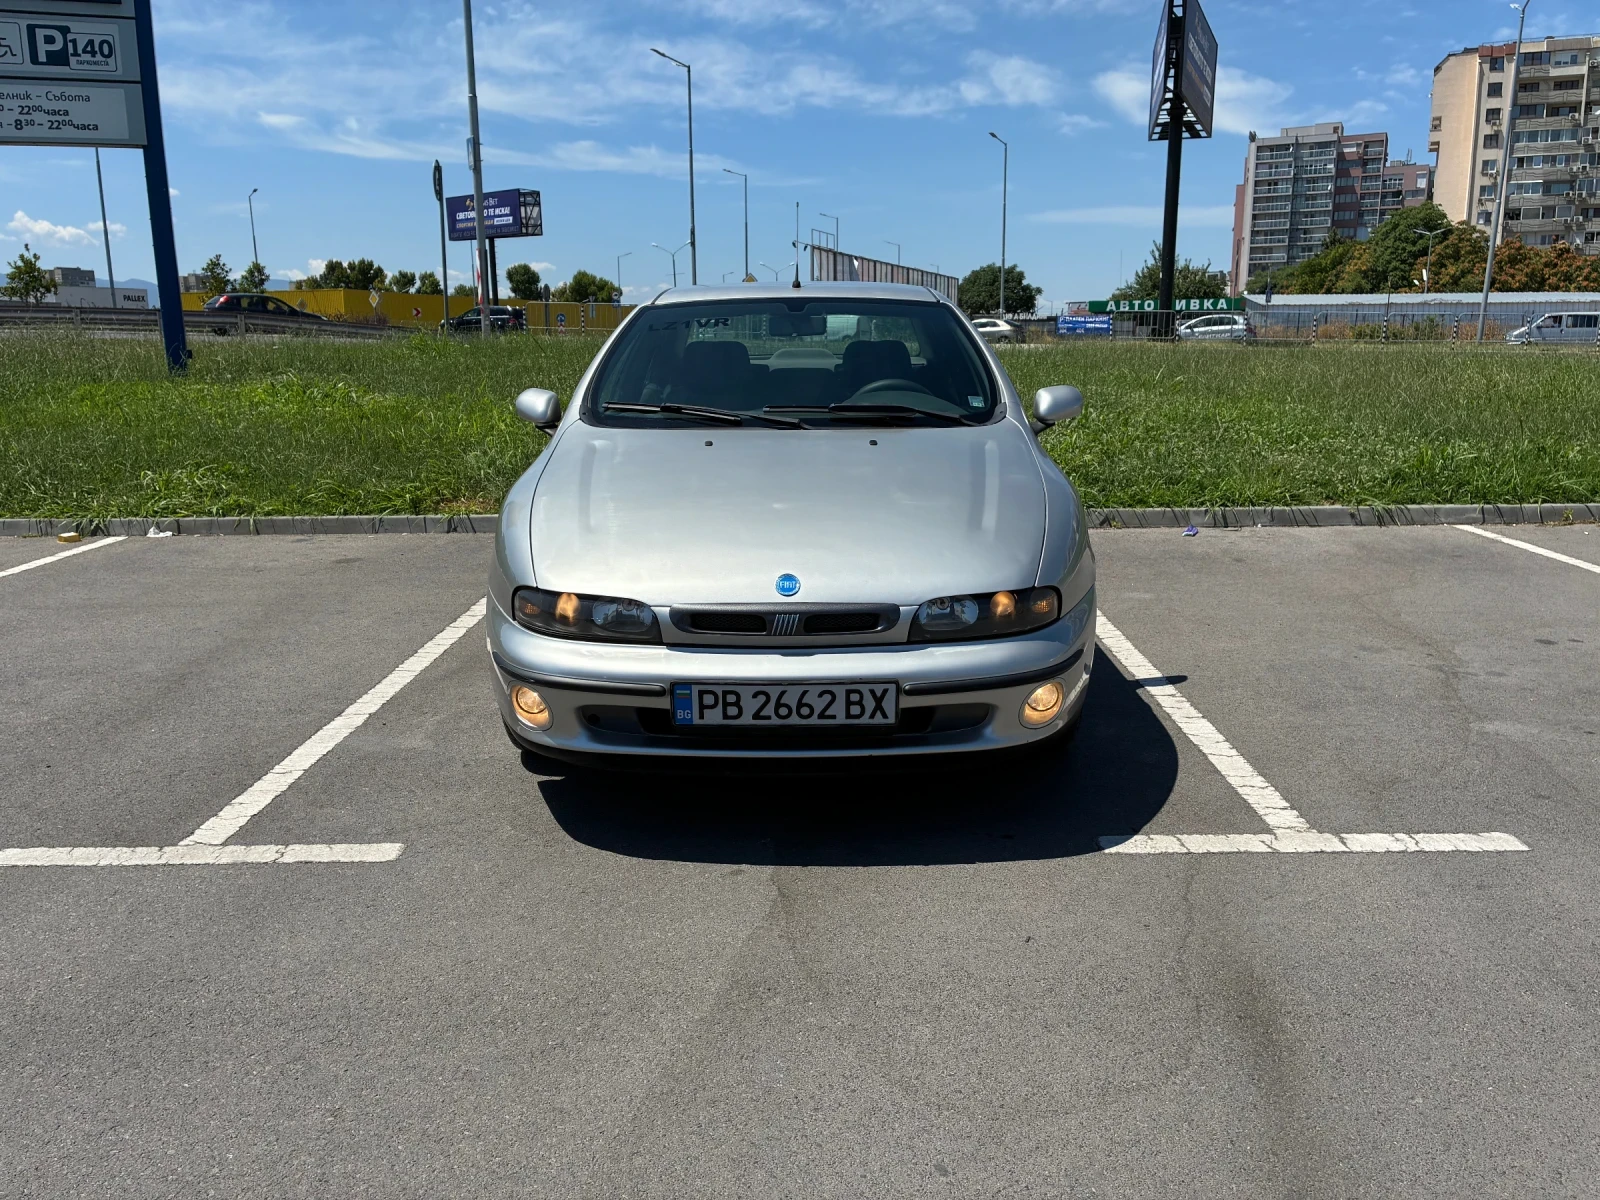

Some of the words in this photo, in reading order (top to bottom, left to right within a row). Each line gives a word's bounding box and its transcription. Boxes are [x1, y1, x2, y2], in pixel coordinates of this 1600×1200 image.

[35, 28, 63, 62] P
[69, 38, 114, 59] 140
[76, 59, 110, 67] ПАРКОМЕСТА
[45, 91, 91, 102] Събота
[123, 294, 146, 302] PALLEX
[1106, 298, 1228, 312] АВТОИВКА
[648, 317, 730, 332] LZ1VR
[779, 580, 796, 589] FIAT
[677, 709, 692, 720] BG
[751, 689, 837, 721] 2662
